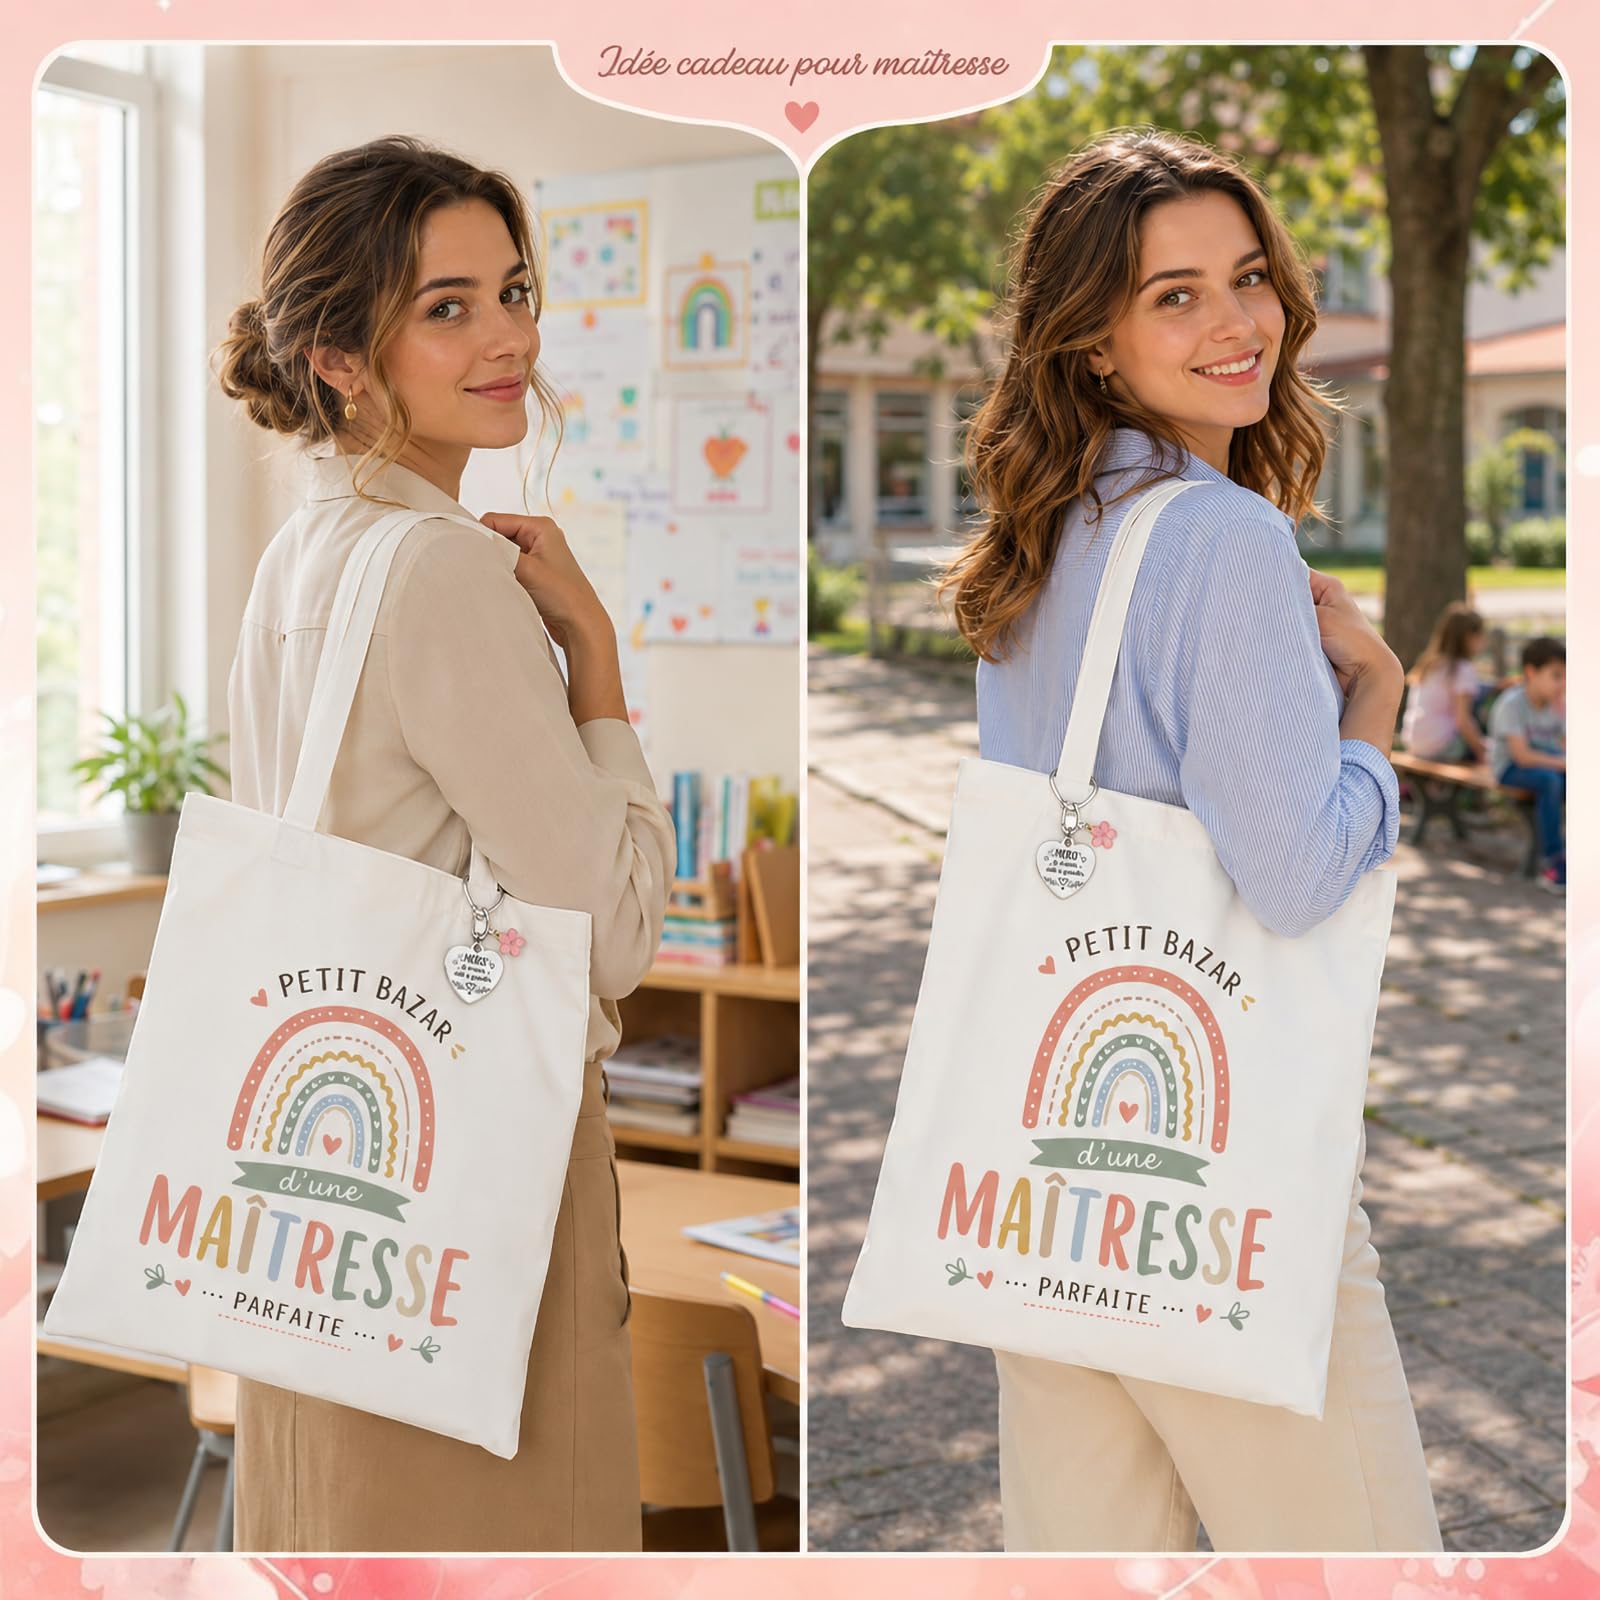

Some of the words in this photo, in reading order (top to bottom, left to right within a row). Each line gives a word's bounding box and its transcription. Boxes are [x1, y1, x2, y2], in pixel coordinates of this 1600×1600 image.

[1065, 925, 1153, 963] PETIT
[1163, 930, 1242, 997] BAZAR
[278, 967, 367, 998] PETIT
[375, 975, 453, 1044] BAZAR
[278, 1169, 364, 1202] d'une
[1076, 1141, 1164, 1171] d'une
[138, 1174, 470, 1328] MAÎTRESSE
[937, 1161, 1273, 1292] MAÎTRESSE
[232, 1290, 345, 1339] PARFAITE
[1037, 1276, 1152, 1315] PARFAITE
